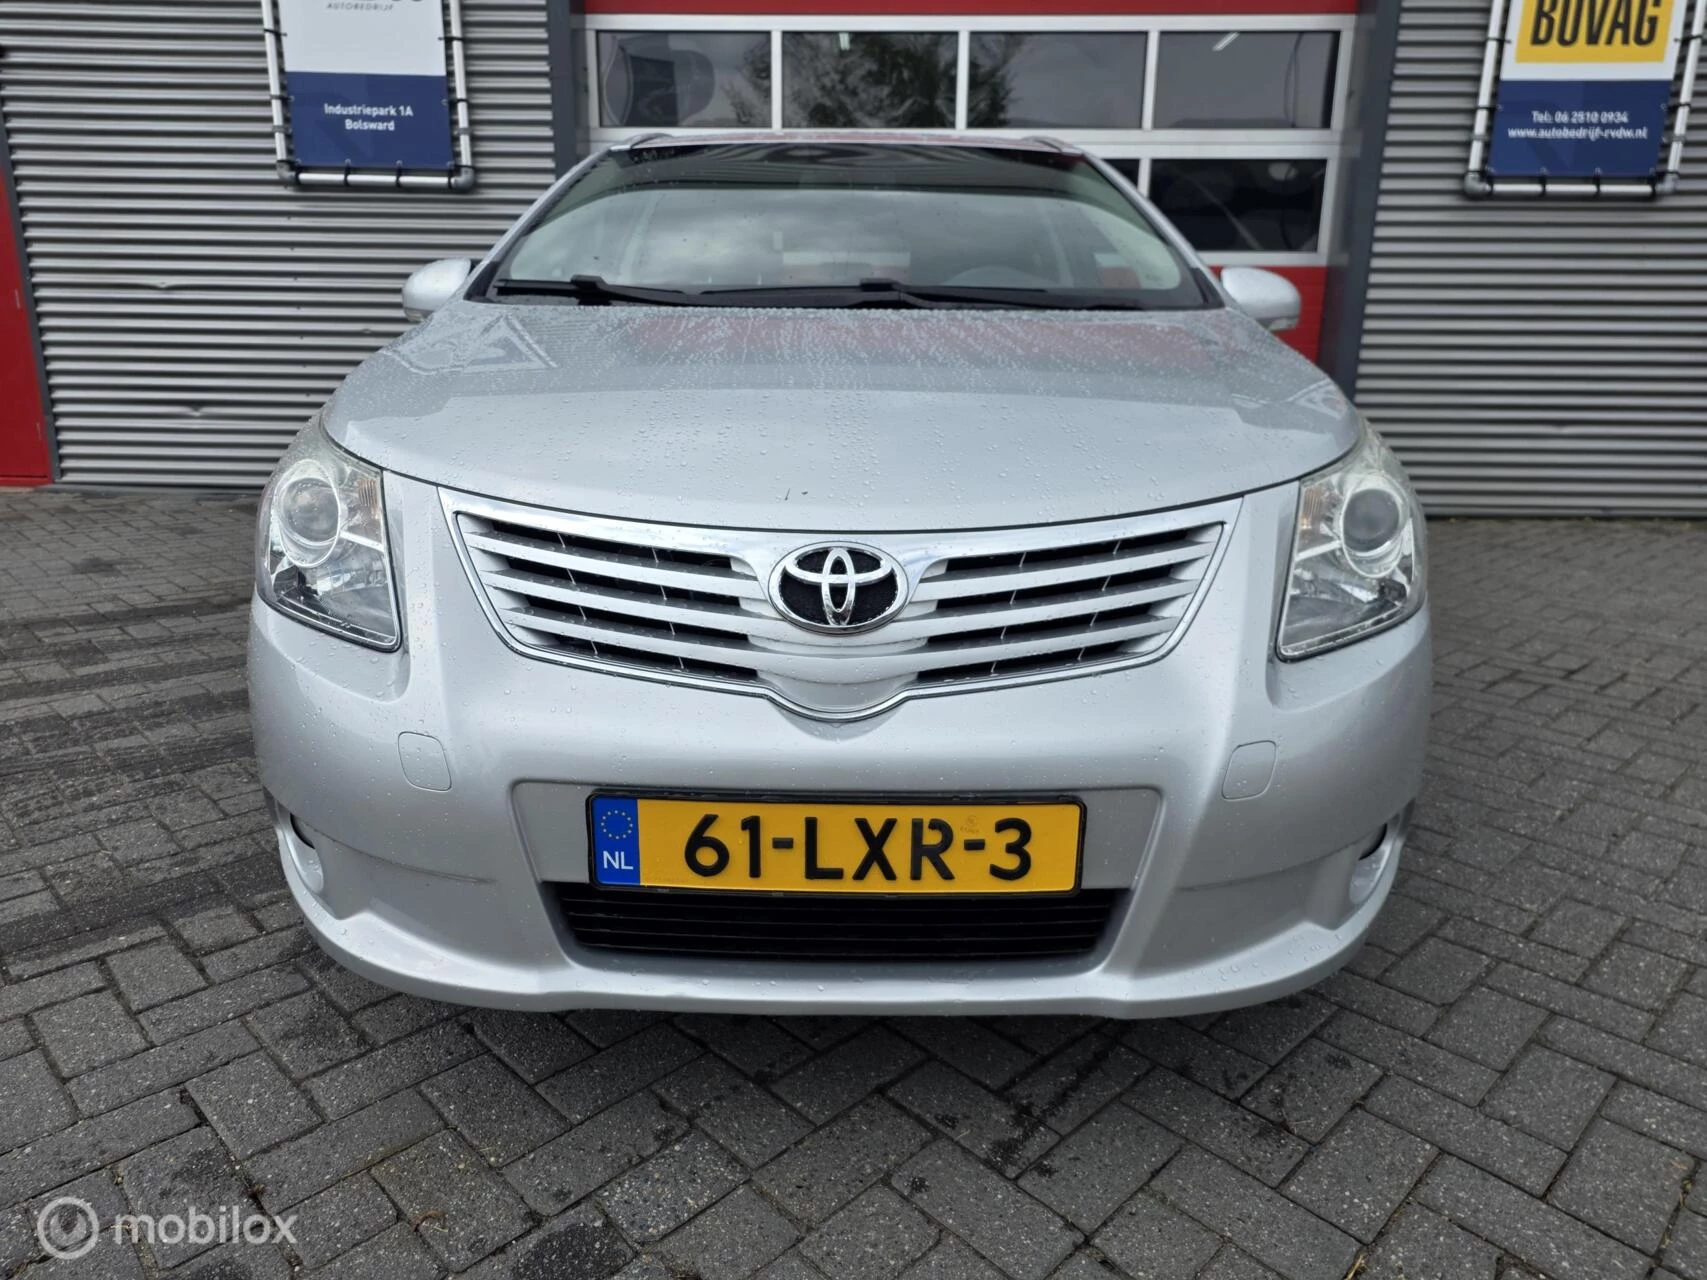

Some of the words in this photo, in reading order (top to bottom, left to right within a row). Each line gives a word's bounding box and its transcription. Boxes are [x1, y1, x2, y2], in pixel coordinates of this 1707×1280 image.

[327, 2, 394, 11] AUTOBEDRIJF
[1530, 0, 1665, 46] BOVAG
[324, 103, 397, 117] Industriepark
[399, 105, 413, 116] 1A
[1554, 110, 1569, 123] 06
[345, 119, 395, 131] Bolsward
[1507, 126, 1648, 141] www.autobedrijf-rvdw.nl
[684, 813, 1032, 882] 61-LXR-3
[602, 850, 634, 871] NL
